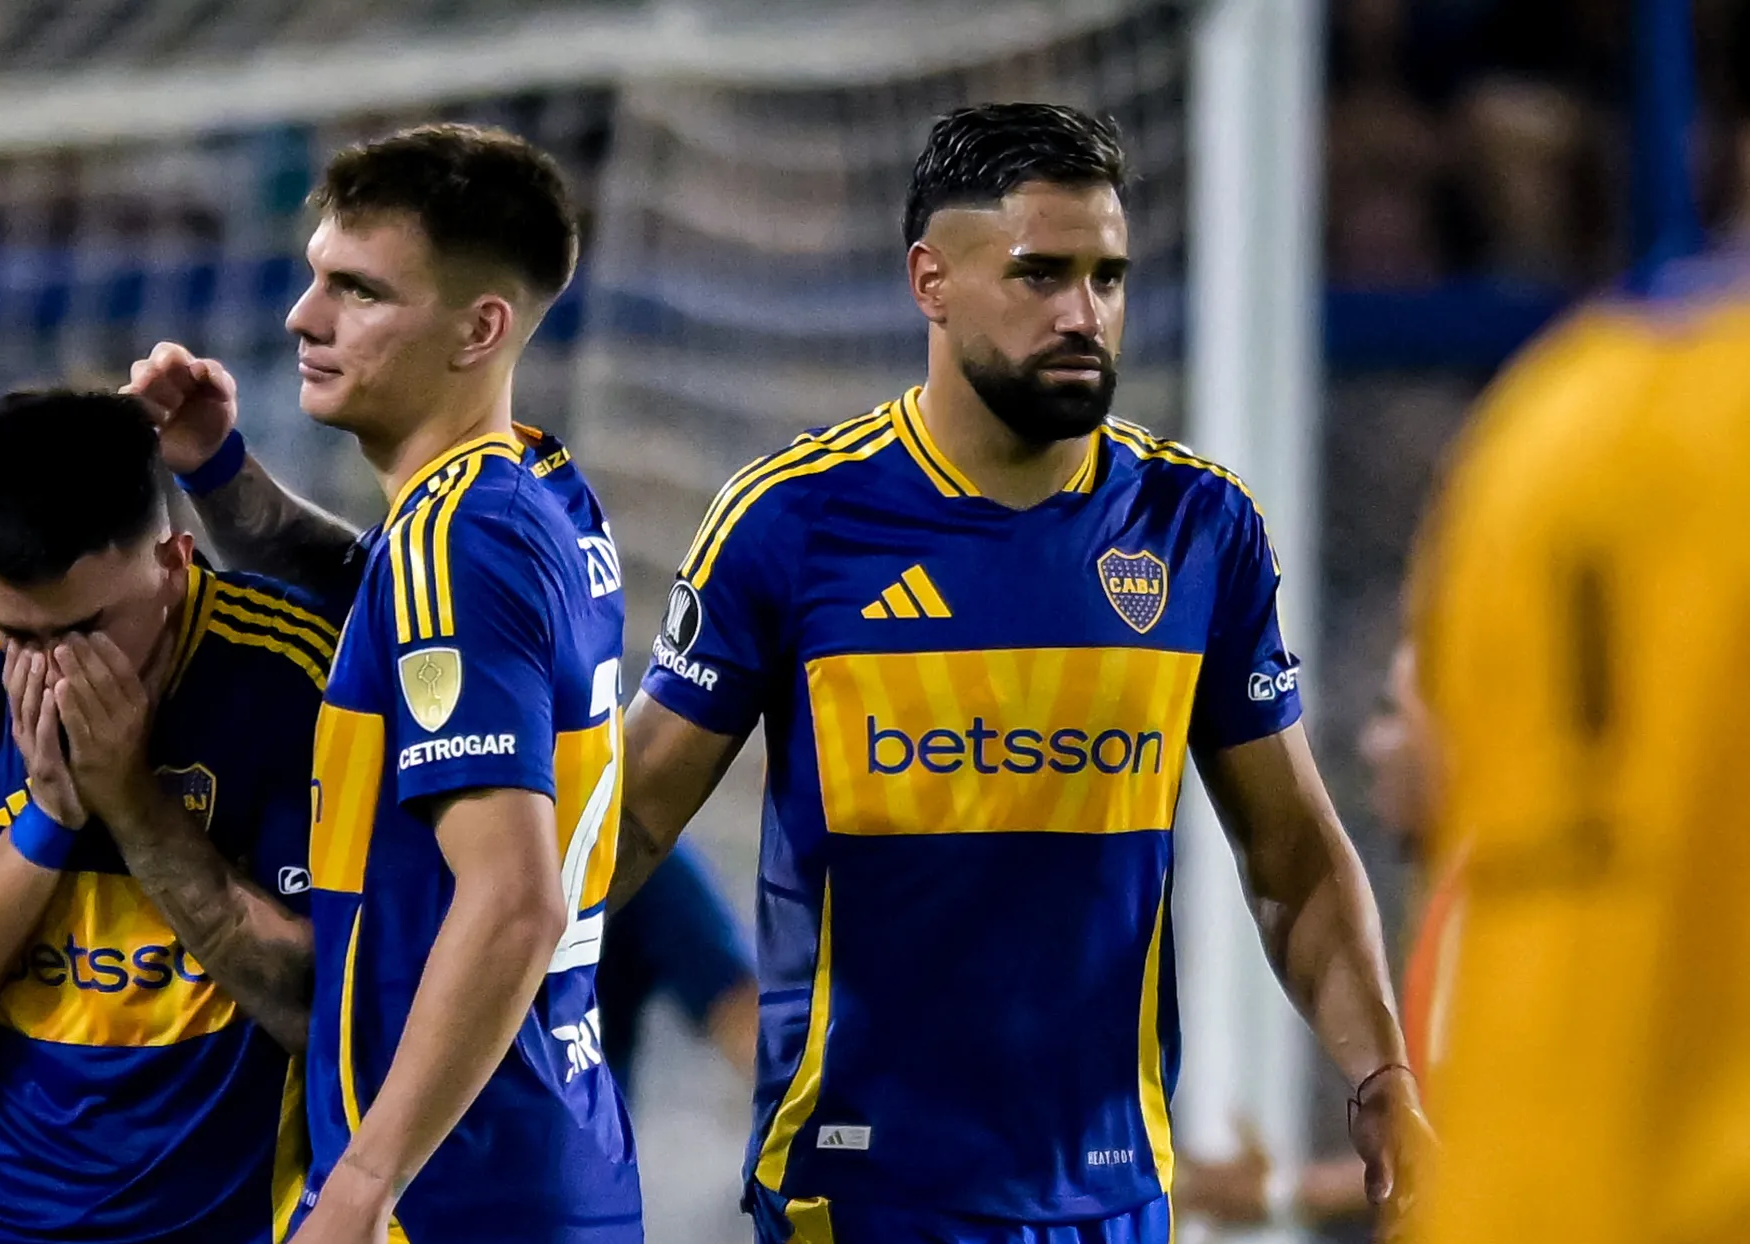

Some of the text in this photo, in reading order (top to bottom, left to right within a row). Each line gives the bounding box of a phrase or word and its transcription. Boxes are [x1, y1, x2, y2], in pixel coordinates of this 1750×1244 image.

[1109, 576, 1161, 596] CABJ
[398, 733, 516, 770] CETROGAR
[867, 714, 1164, 775] betsson
[546, 657, 622, 970] 2
[17, 933, 208, 993] etsso
